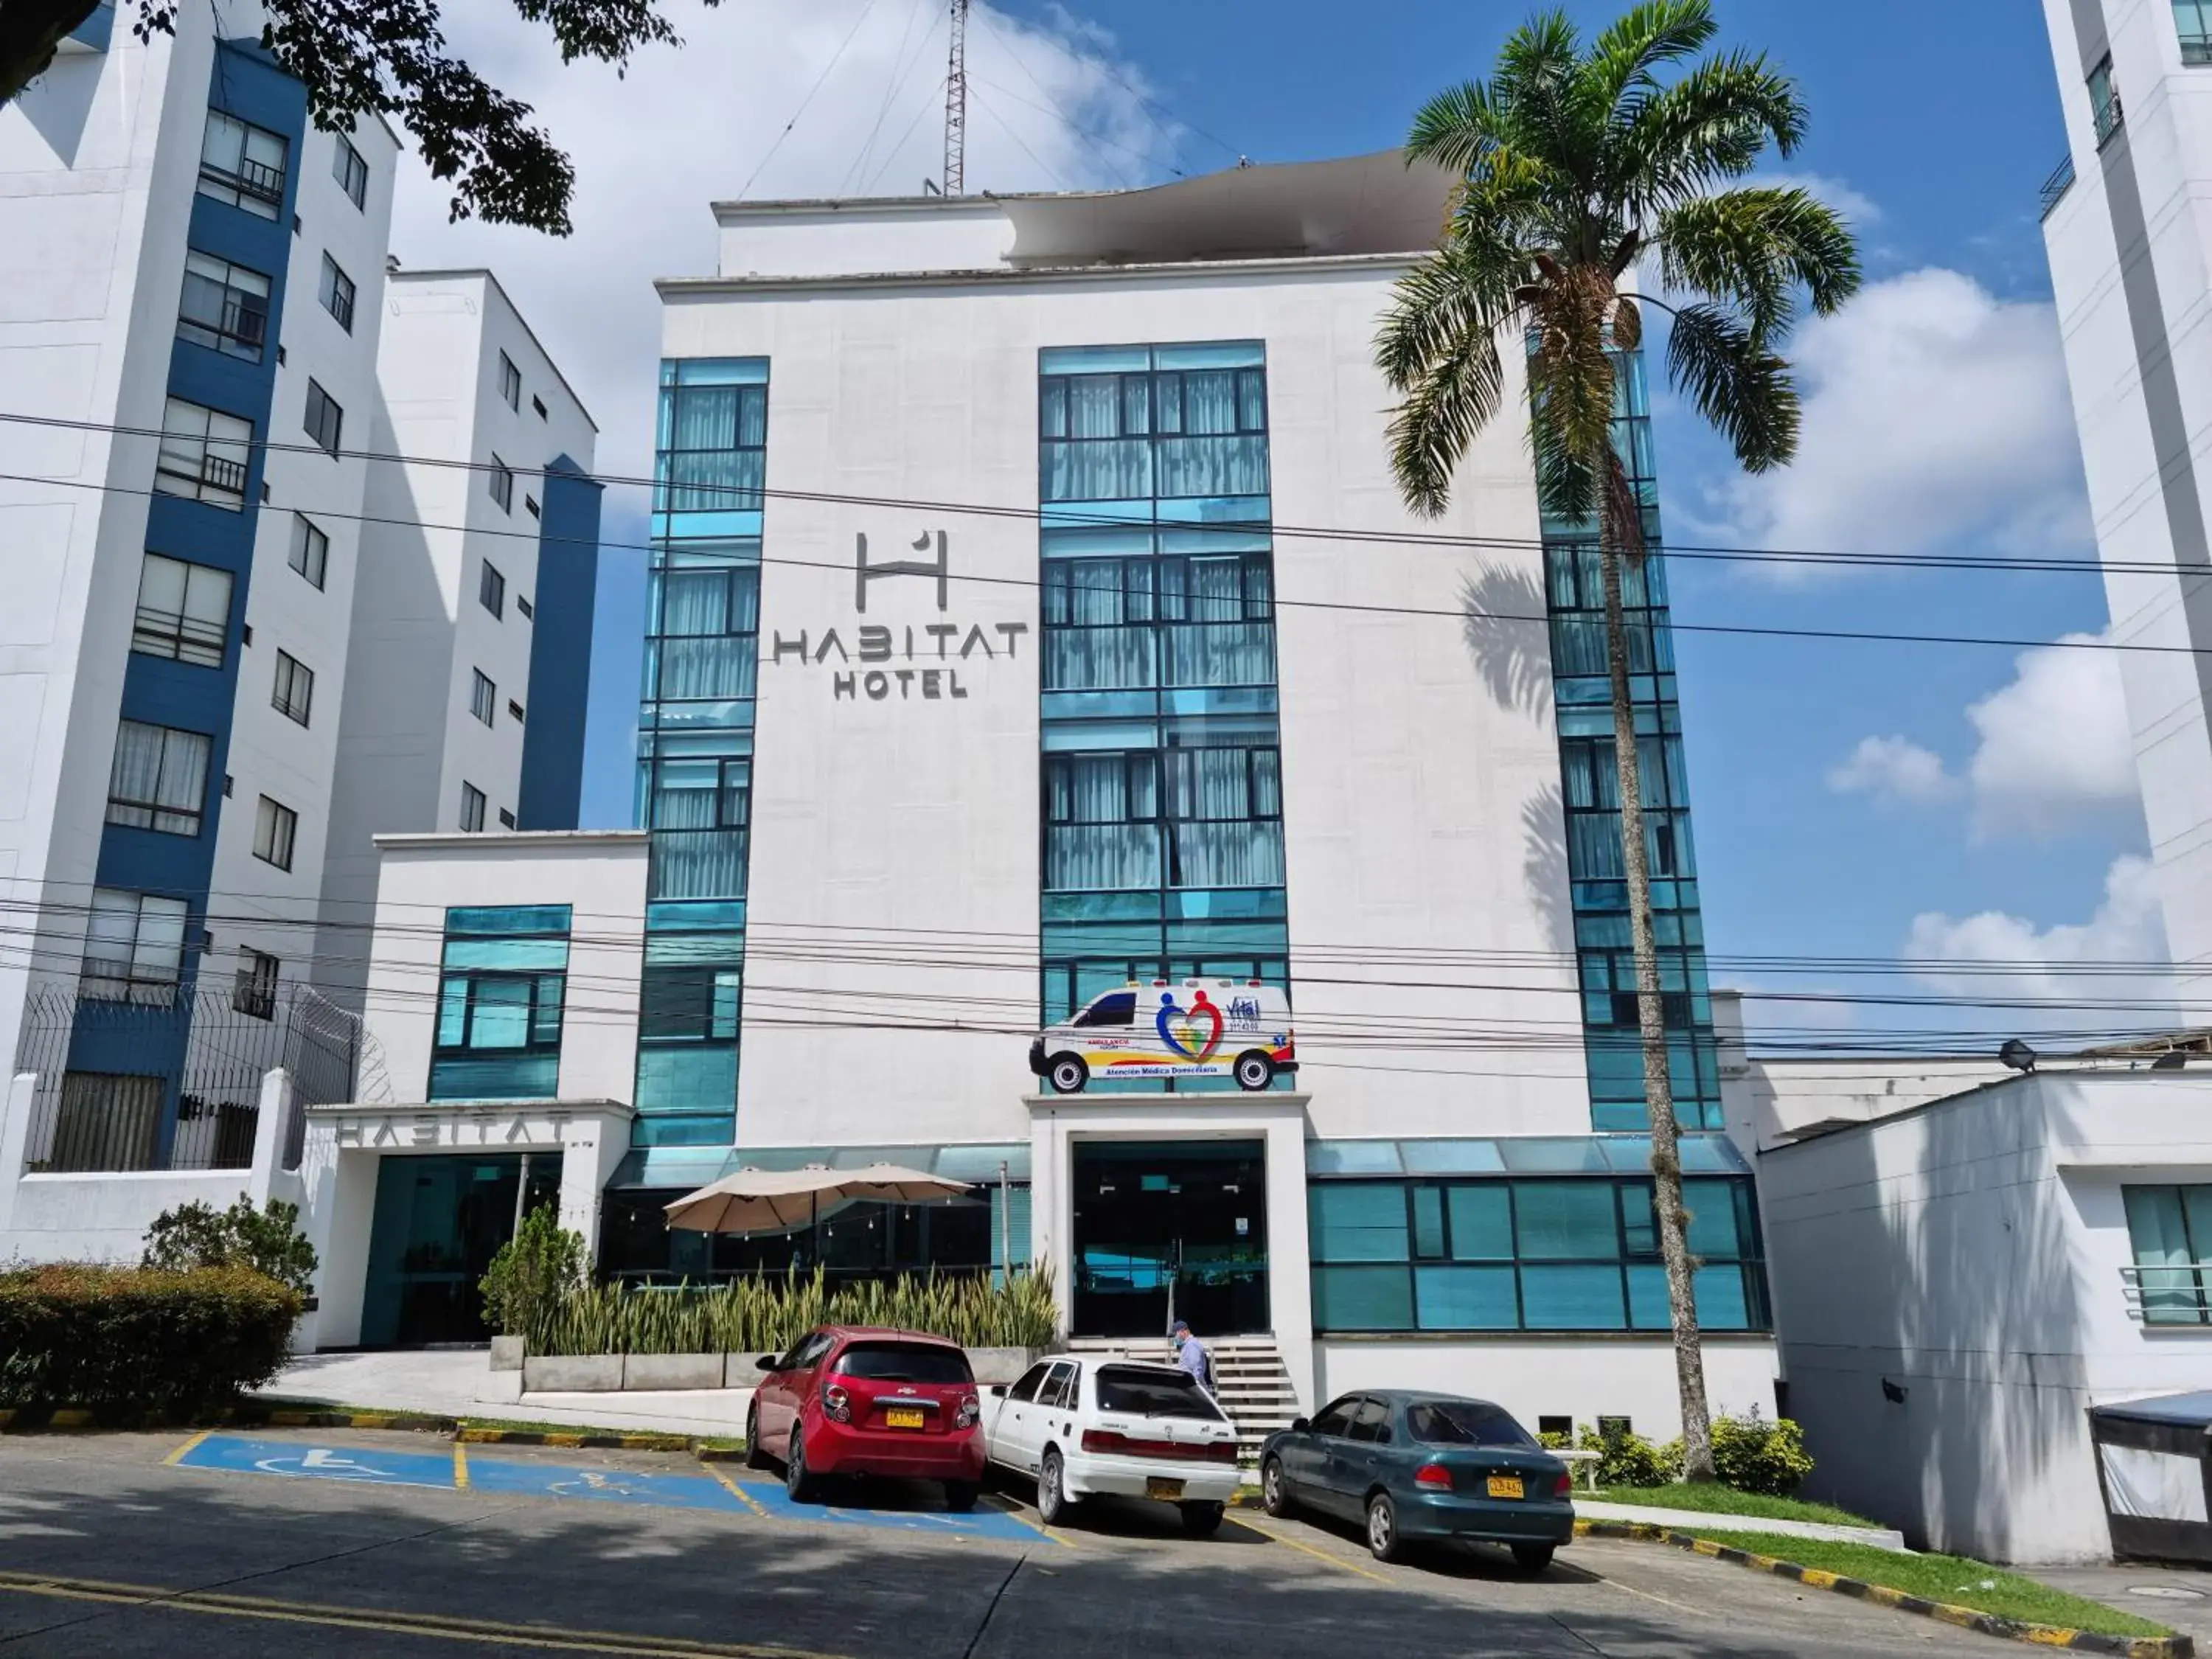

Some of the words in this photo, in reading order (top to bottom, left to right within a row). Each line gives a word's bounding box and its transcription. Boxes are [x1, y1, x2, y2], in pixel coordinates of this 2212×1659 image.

[773, 622, 1029, 667] HABITAT
[834, 669, 968, 700] HOTEL
[1106, 1066, 1141, 1076] Atención
[1142, 1066, 1170, 1074] Médica
[334, 1110, 573, 1147] HABITAT
